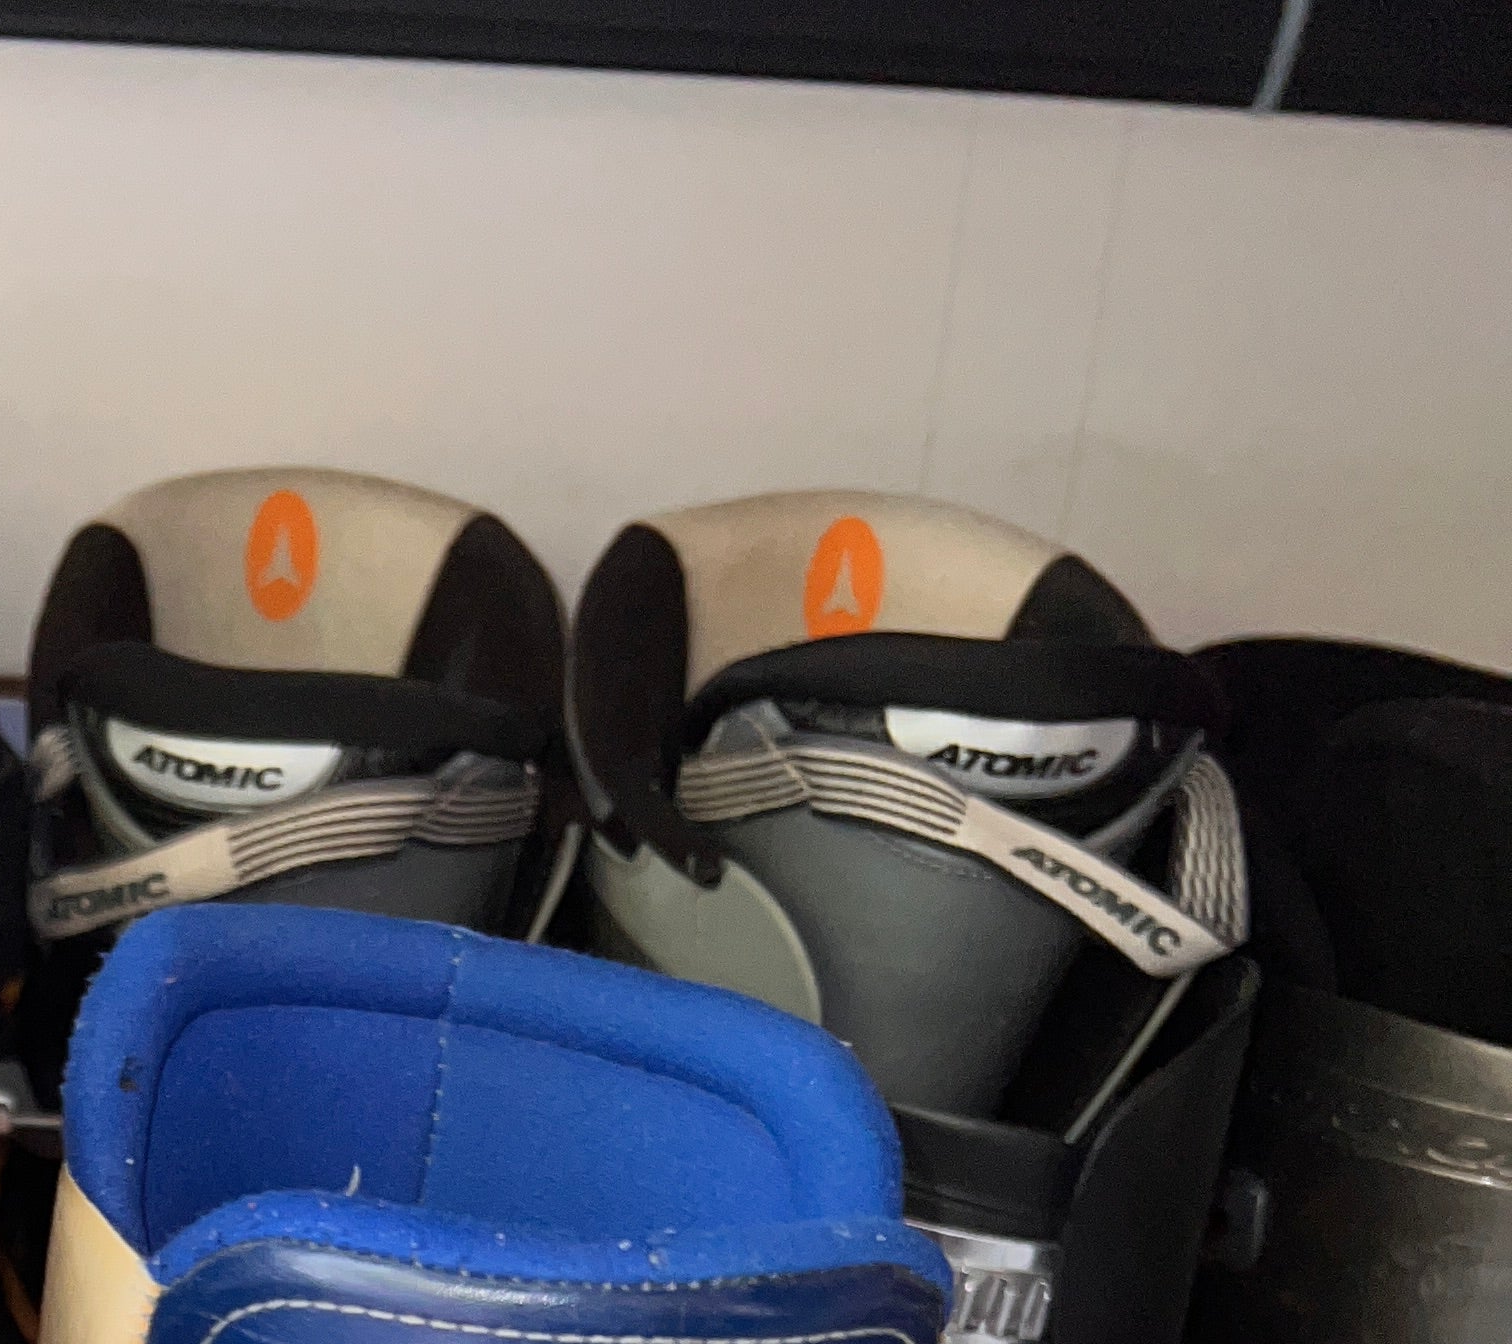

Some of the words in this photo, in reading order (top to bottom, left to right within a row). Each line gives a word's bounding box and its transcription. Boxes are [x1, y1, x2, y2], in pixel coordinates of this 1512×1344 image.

[133, 744, 285, 792] ATOMIC
[927, 743, 1099, 779] ATOMIC
[1011, 846, 1184, 958] ATOMIC
